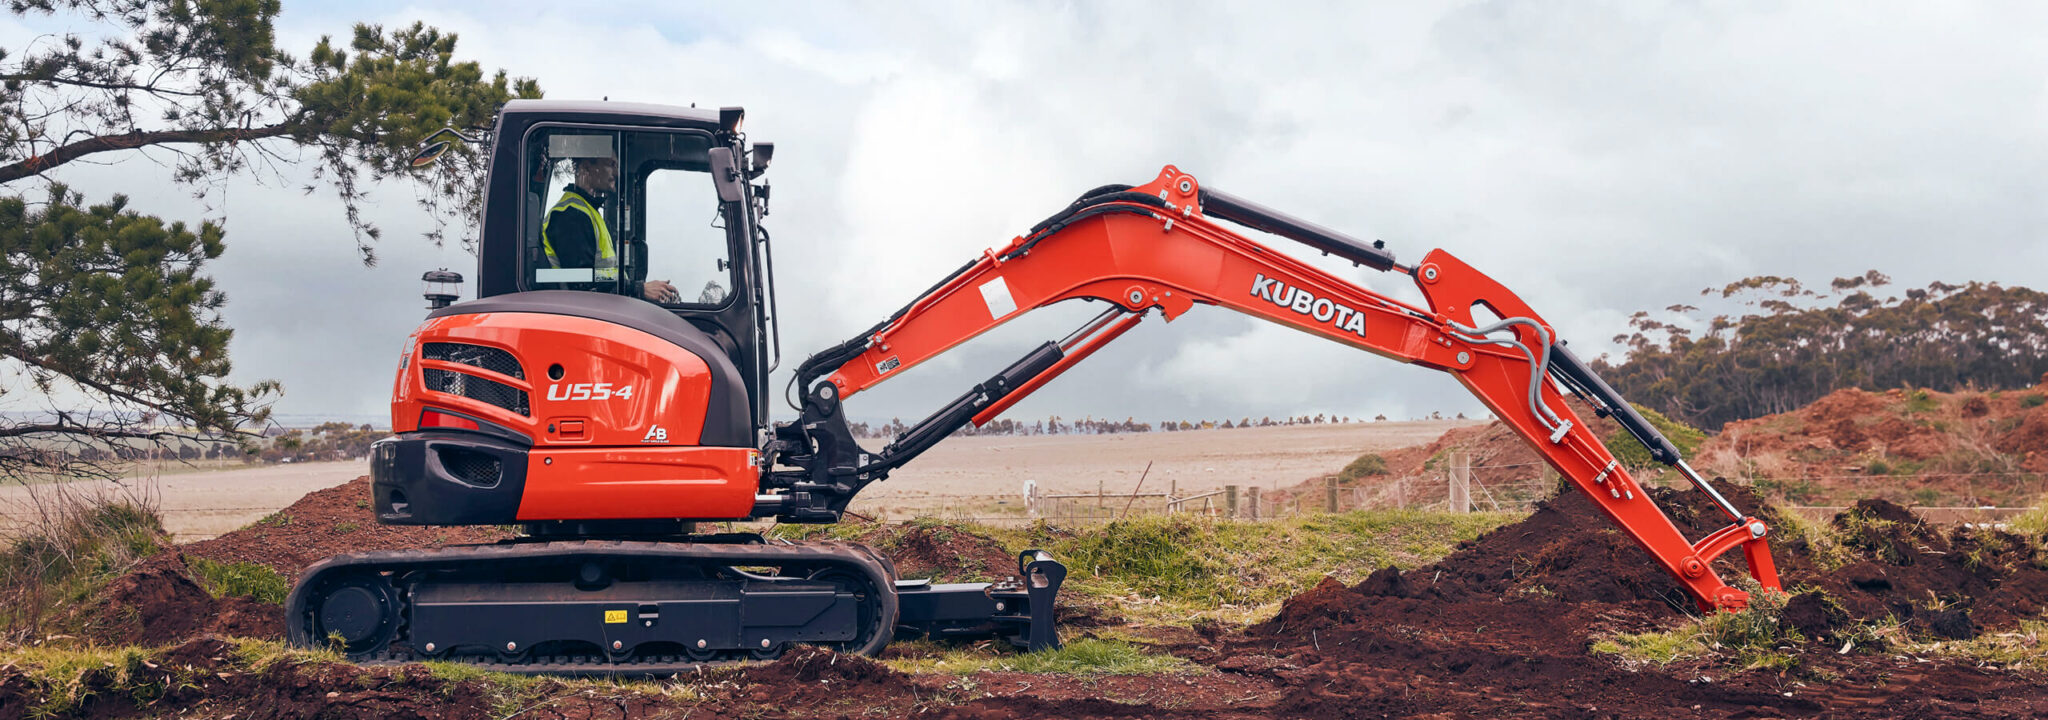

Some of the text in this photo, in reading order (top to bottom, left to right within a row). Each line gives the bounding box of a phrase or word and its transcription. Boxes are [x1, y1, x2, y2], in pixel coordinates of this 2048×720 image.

[1250, 273, 1366, 337] KUBOTA
[547, 383, 633, 401] U55-4
[644, 424, 667, 440] AB
